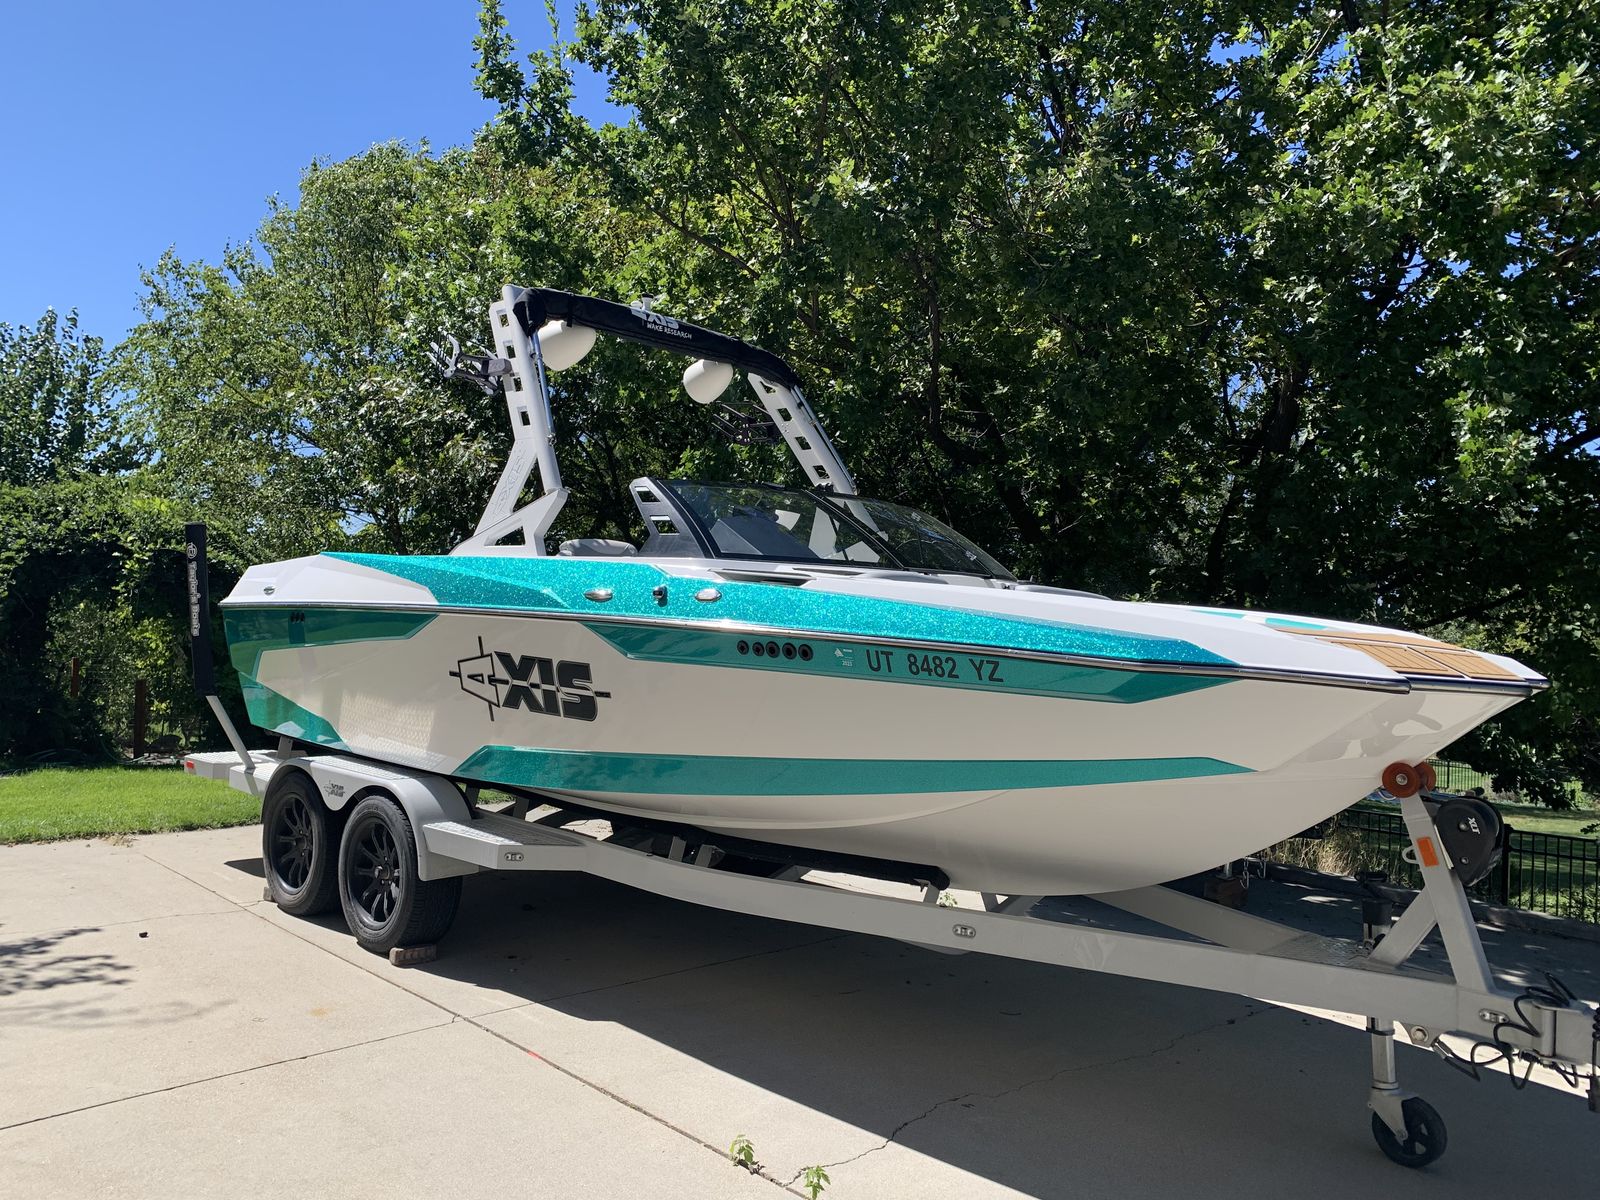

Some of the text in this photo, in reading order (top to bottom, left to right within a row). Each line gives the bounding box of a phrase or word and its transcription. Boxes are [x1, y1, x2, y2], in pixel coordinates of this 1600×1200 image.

[646, 322, 692, 340] WAKE RESEARCH
[190, 604, 200, 637] Boats
[866, 649, 1004, 683] UT 8482 YZ
[458, 651, 598, 722] AXIS
